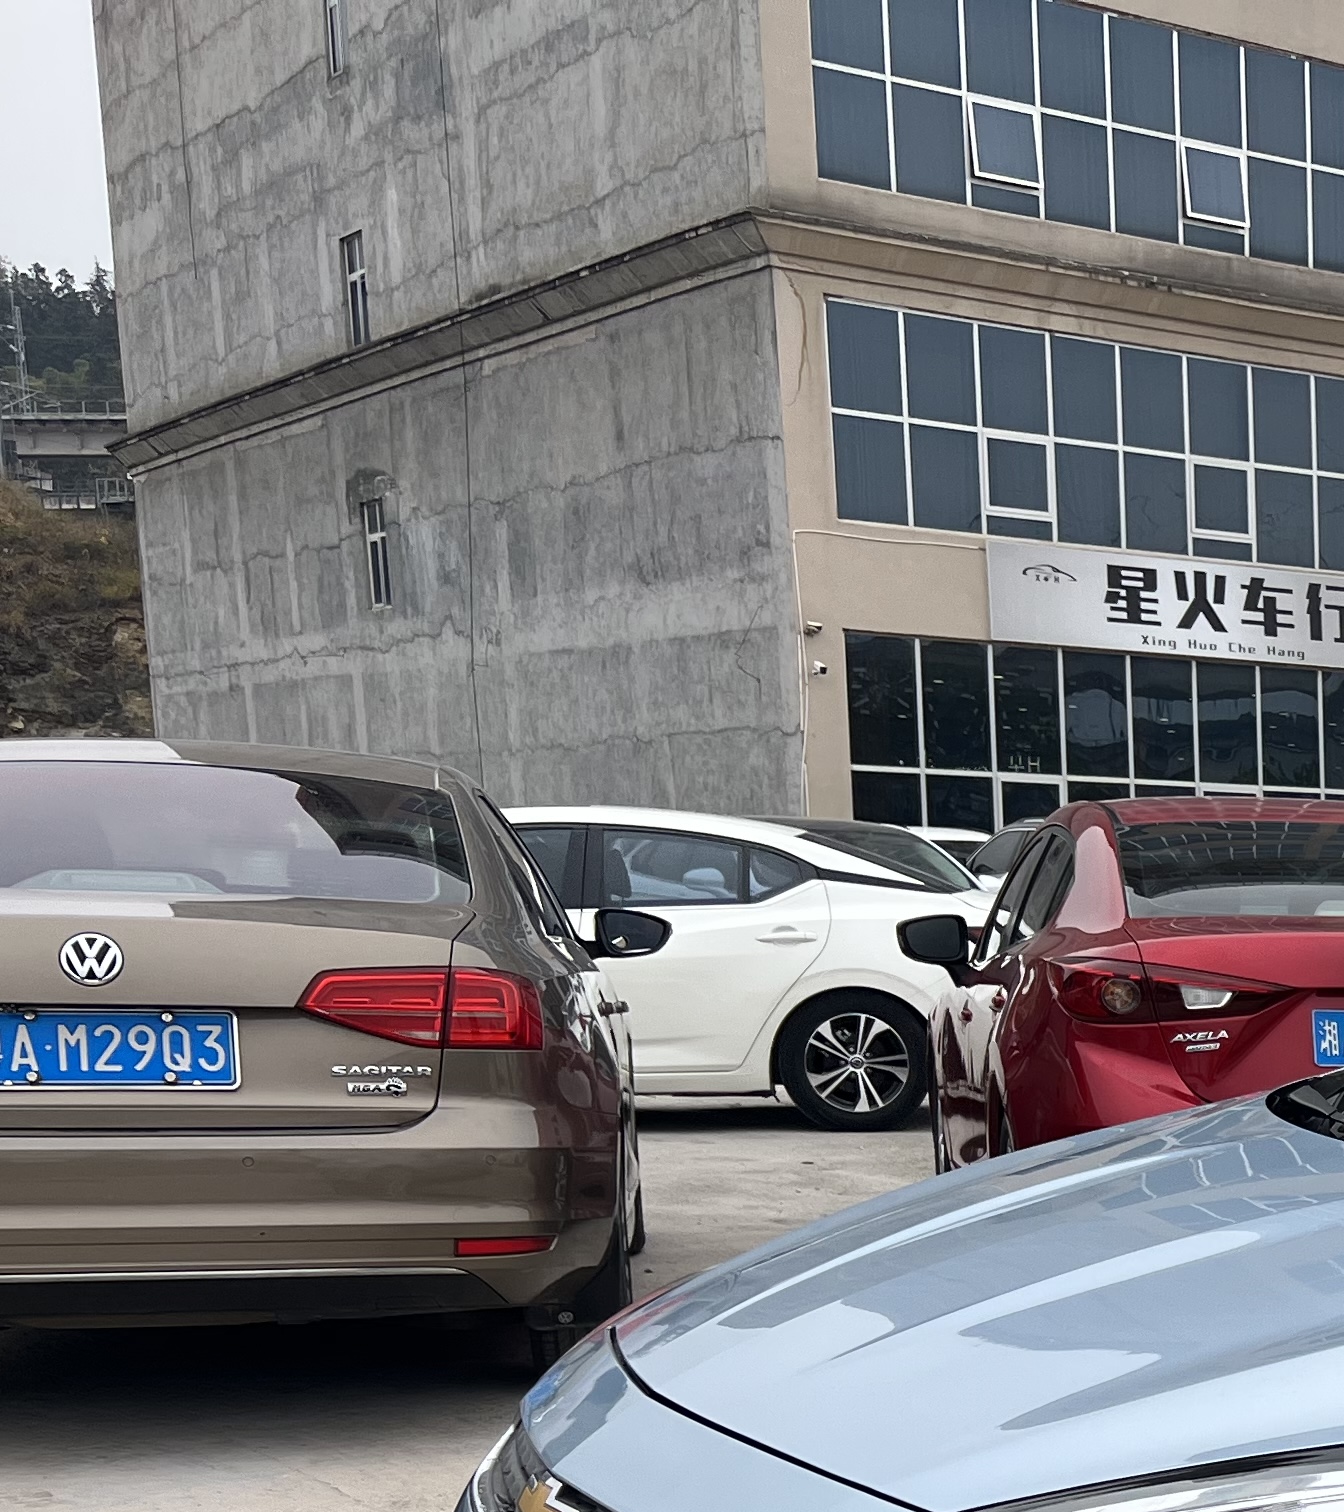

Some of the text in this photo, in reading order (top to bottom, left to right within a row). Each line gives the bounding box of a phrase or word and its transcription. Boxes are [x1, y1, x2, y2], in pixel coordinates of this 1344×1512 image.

[1141, 634, 1306, 661] Xing Huo Che Hang
[1170, 1030, 1229, 1043] AXELA
[0, 1024, 226, 1072] A·M29Q3
[331, 1065, 432, 1076] SAGITAR
